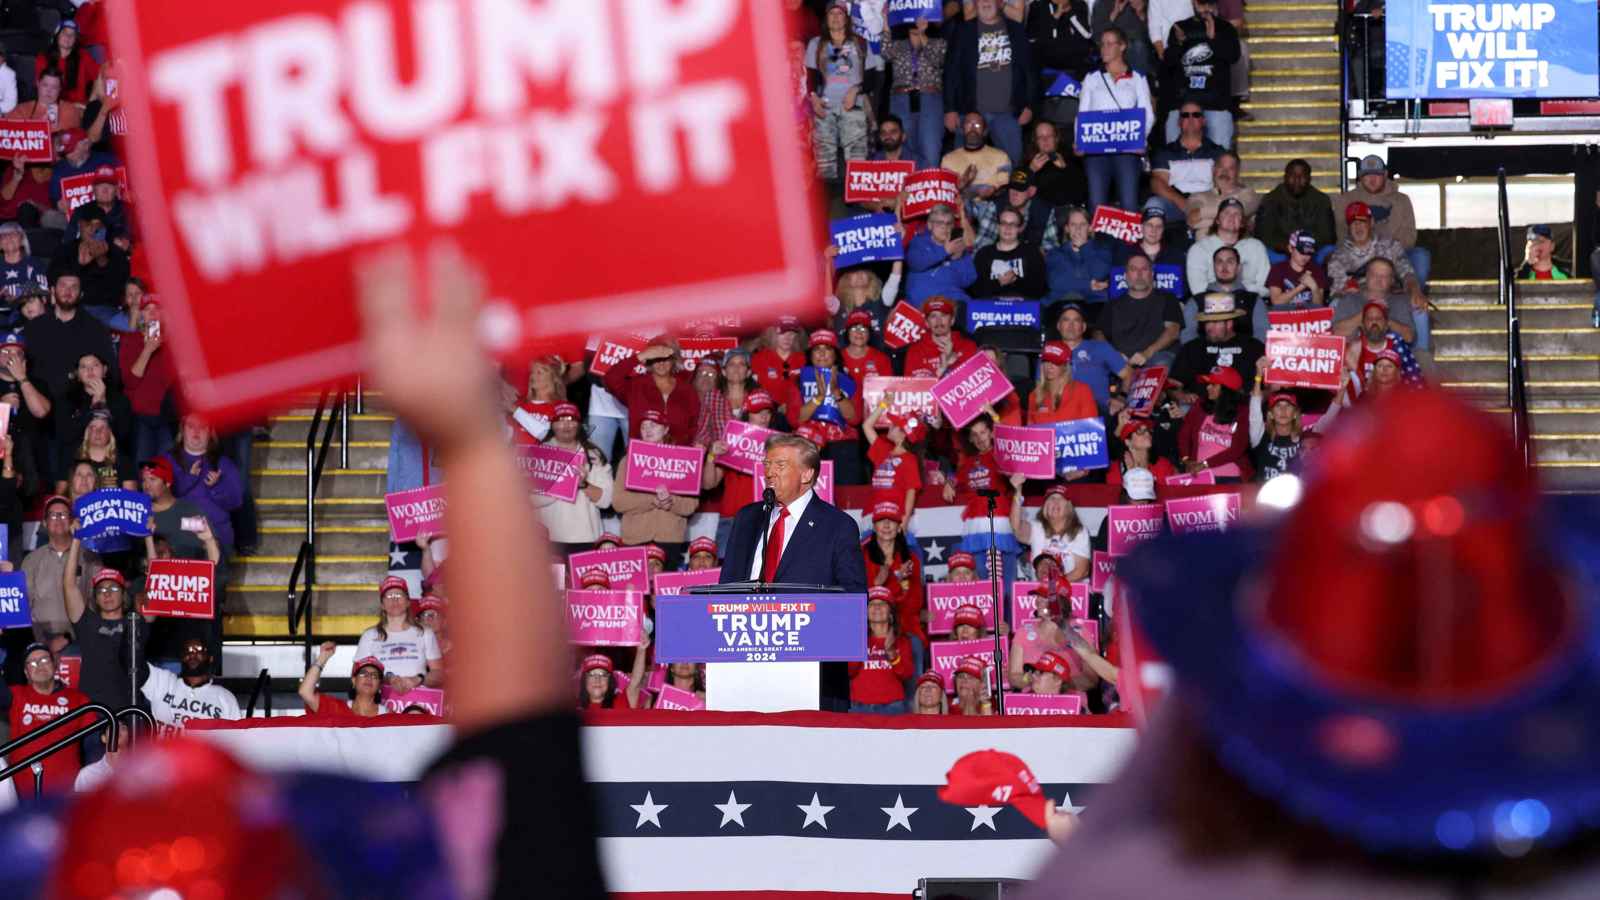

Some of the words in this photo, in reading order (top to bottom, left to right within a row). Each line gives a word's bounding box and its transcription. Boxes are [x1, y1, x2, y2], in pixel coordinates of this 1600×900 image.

[1428, 3, 1556, 31] TRUMP
[1446, 31, 1538, 60] WILL
[1436, 60, 1496, 89] FIX
[1505, 60, 1549, 89] IT!
[148, 0, 743, 182] TRUMP
[27, 130, 48, 140] BIG,
[1081, 120, 1141, 134] TRUMP
[0, 138, 44, 151] GAIN!
[1081, 133, 1108, 143] WILL
[1110, 132, 1128, 142] FIX
[1130, 131, 1140, 141] IT
[173, 148, 412, 281] WILL
[420, 112, 614, 225] FIX
[630, 82, 748, 192] IT
[851, 182, 876, 192] WILL
[879, 182, 897, 192] FIX
[905, 179, 940, 194] DREAM
[907, 189, 956, 206] AGAIN!
[834, 225, 897, 247] TRUMP
[838, 241, 864, 255] WILL
[866, 238, 884, 250] FIX
[886, 237, 897, 248] IT
[971, 312, 1012, 322] DREAM
[1013, 313, 1037, 323] BIG,
[1271, 345, 1315, 358] DREAM
[1316, 348, 1341, 361] BIG,
[1271, 356, 1335, 374] AGAIN!
[940, 363, 997, 407] WOMEN
[967, 379, 993, 402] TRUMP
[868, 391, 934, 405] TUMP
[727, 433, 765, 454] WOM
[1078, 432, 1102, 442] BIG,
[996, 438, 1050, 456] WOMEN
[633, 453, 698, 473] WOMEN
[1011, 454, 1040, 463] TRUMP
[653, 471, 687, 480] TRUMP
[80, 499, 121, 517] DREAM
[124, 500, 148, 515] BIG,
[82, 507, 142, 529] AGAIN!
[1113, 518, 1161, 534] WOME
[149, 574, 210, 593] TRUMP
[147, 590, 175, 601] WILL
[177, 591, 197, 602] FIX
[198, 592, 209, 603] IT
[570, 604, 639, 620] WOMEN
[712, 604, 749, 613] TRUMP
[751, 603, 777, 612] WILL
[780, 603, 797, 612] FIX
[800, 602, 811, 612] IT
[592, 619, 627, 628] TRUMP
[712, 613, 811, 632] TRUMP
[723, 631, 800, 646] VANCE
[746, 652, 777, 661] 2024
[23, 703, 69, 715] AGAIN!
[162, 691, 223, 720] BLACKS
[991, 784, 1014, 803] 47
